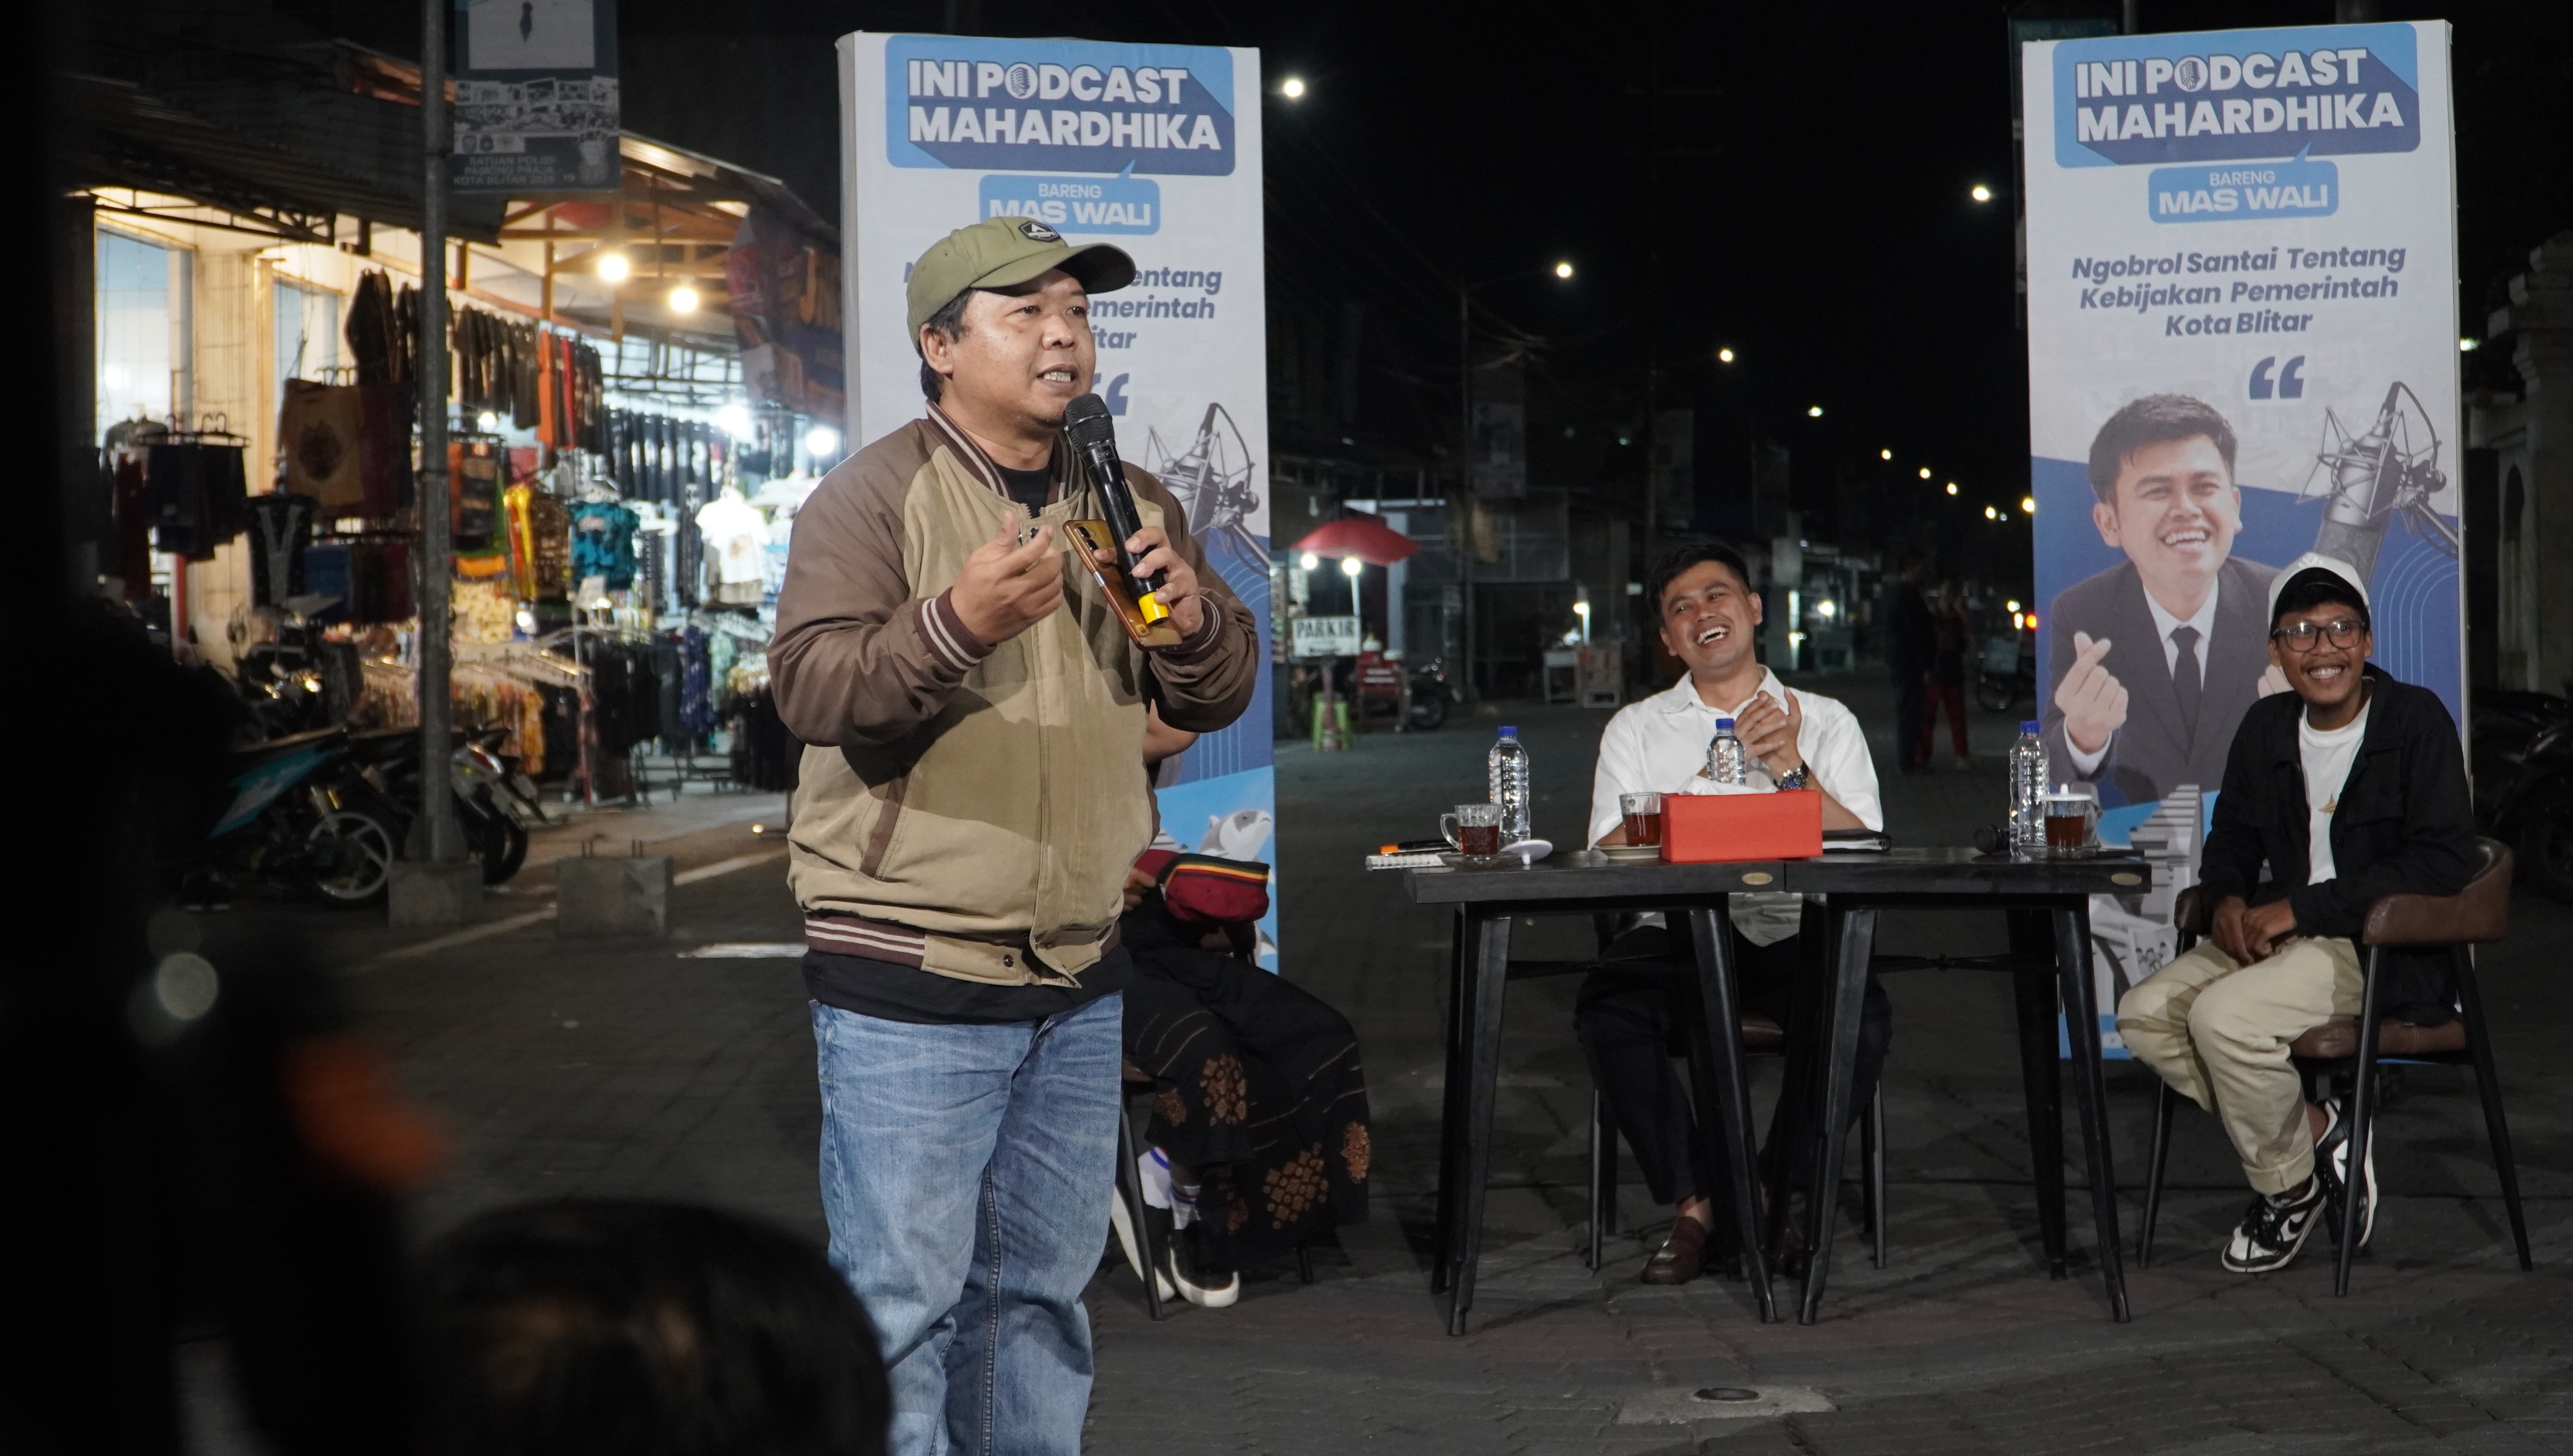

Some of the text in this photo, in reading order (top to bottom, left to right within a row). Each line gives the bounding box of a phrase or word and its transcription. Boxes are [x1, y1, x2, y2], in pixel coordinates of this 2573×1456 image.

[908, 59, 1188, 104] INI PODCAST
[2075, 49, 2367, 99] INI PODCAST
[909, 106, 1222, 150] MAHARDHIKA
[2078, 92, 2404, 141] MAHARDHIKA
[1038, 183, 1101, 198] BARENG
[2210, 171, 2276, 186] BARENG
[989, 200, 1151, 226] MAS WALI
[2159, 184, 2328, 214] MAS WALI
[2072, 246, 2406, 285] Ngobrol Santai Tentang
[1130, 267, 1222, 295] entang
[2080, 275, 2398, 314] Kebijakan Pemerintah
[2165, 309, 2313, 337] Kota Blitar
[1296, 621, 1354, 638] PARKIR
